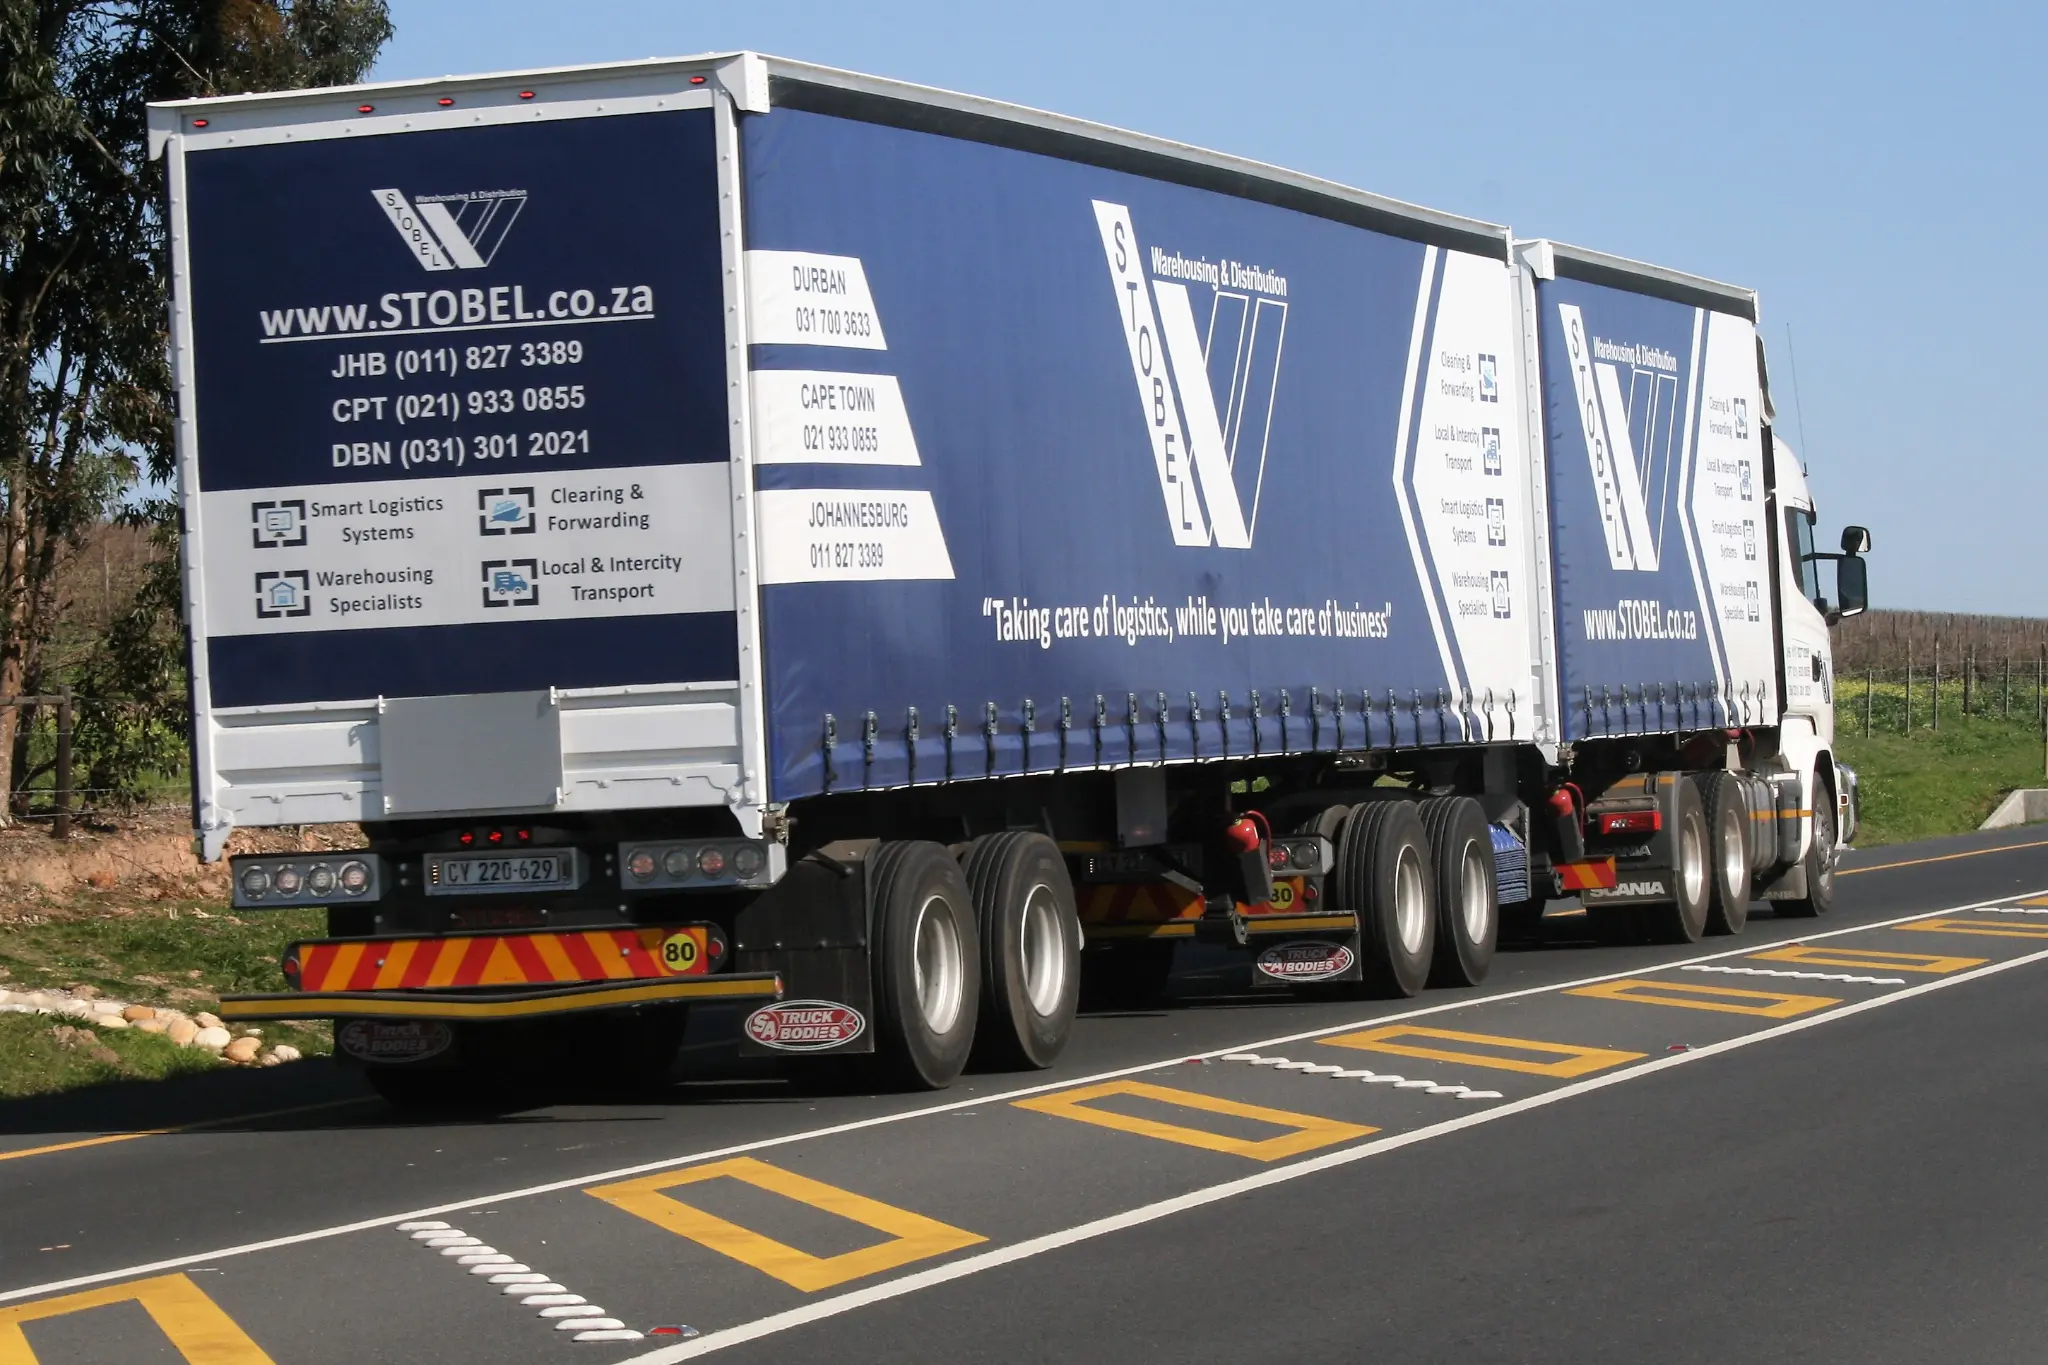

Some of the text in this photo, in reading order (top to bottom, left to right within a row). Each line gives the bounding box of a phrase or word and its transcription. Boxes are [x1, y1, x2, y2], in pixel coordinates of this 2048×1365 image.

[415, 191, 469, 203] Warehousing
[479, 189, 527, 199] Distribution
[386, 193, 441, 266] STOBEL
[793, 266, 846, 295] DURBAN
[1151, 246, 1287, 297] Warehousing & Distribution
[260, 284, 654, 338] www.STOBEL.co.za
[796, 307, 870, 337] 031 700 3633
[331, 340, 584, 380] JHB (011) 827 3389
[1441, 351, 1471, 373] Clearing &
[1593, 336, 1677, 372] Warehousing & Distribution
[1115, 221, 1192, 531] STOBEL
[801, 383, 875, 412] CAPE TOWN
[1441, 379, 1474, 402] Forwarding
[332, 385, 586, 427] CPT (021) 933 0855
[803, 425, 878, 451] 021 933 0855
[1435, 424, 1480, 448] Local & Intercity
[1571, 319, 1622, 557] STOBEL
[332, 429, 591, 471] DBN (031) 301 2021
[1445, 453, 1472, 473] Transport
[311, 495, 444, 518] Smart Logistics
[551, 484, 645, 506] Clearing &
[809, 502, 908, 529] JOHANNESBURG
[1441, 497, 1484, 519] Smart Logistics
[342, 523, 414, 544] Systems
[548, 511, 650, 533] Forwarding
[1452, 526, 1476, 546] Systems
[542, 554, 682, 577] Local & Intercity
[811, 543, 883, 568] 011 827 3389
[316, 566, 434, 588] Warehousing
[1452, 571, 1489, 592] Warehousing
[571, 582, 655, 603] Transport
[329, 595, 423, 614] Specialists
[1458, 599, 1487, 619] Specialists
[1055, 606, 1089, 637] care
[1094, 594, 1108, 636] of
[1112, 595, 1173, 646] logistics,
[1176, 595, 1217, 636] while
[1220, 607, 1248, 645] you
[1251, 596, 1283, 636] take
[1286, 607, 1315, 636] care
[1319, 599, 1332, 636] of
[1584, 600, 1696, 640] www.STOBEL.co.za
[448, 860, 552, 882] CY 220-629
[665, 942, 695, 962] 80
[1287, 949, 1328, 959] TRUCK
[1286, 961, 1334, 972] BODIES
[752, 1014, 776, 1038] SA
[781, 1011, 833, 1024] TRUCK
[780, 1026, 840, 1039] BODIES
